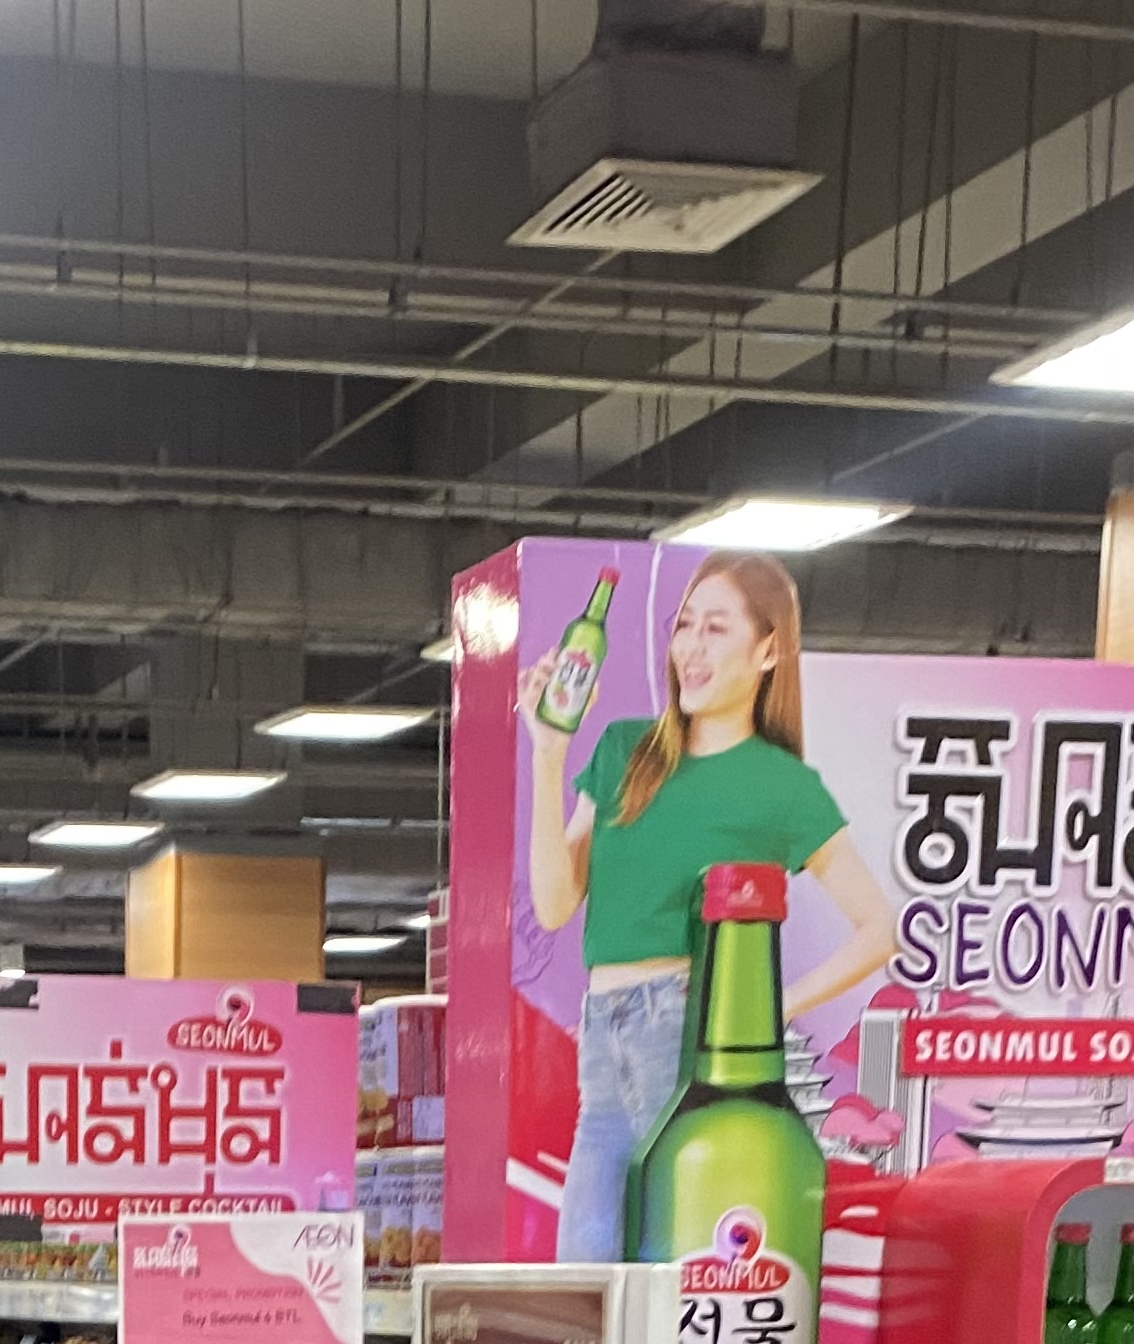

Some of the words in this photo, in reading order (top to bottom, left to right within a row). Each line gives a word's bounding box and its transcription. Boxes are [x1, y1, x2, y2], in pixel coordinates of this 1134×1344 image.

[894, 903, 1134, 988] SEON
[174, 1021, 277, 1053] SEONMUL
[915, 1028, 1078, 1063] SEONMUL
[1089, 1031, 1134, 1063] SO
[43, 1198, 99, 1221] SOJU
